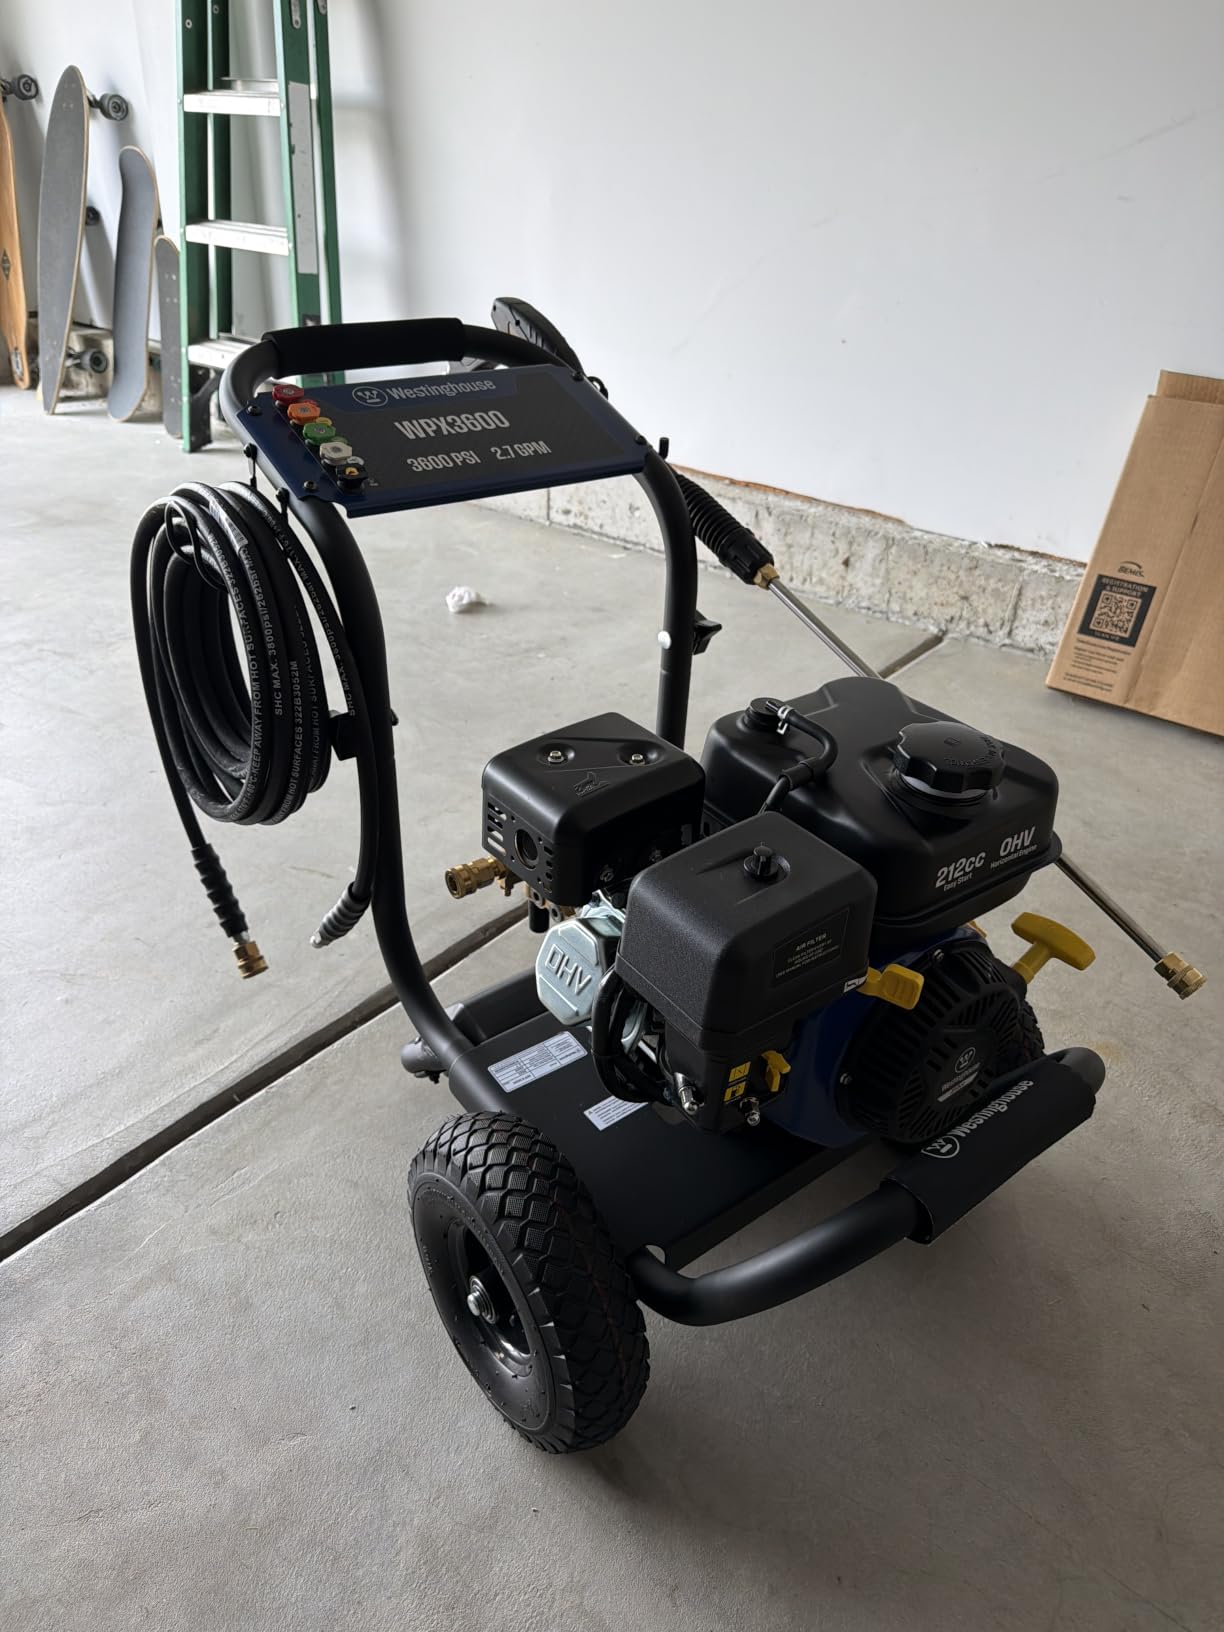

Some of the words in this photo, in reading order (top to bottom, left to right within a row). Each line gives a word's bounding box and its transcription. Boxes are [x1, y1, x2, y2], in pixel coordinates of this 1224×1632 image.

[386, 379, 497, 400] Westinghouse
[394, 410, 511, 440] WPX3600
[406, 454, 454, 472] 3600
[451, 450, 481, 467] PSI
[490, 446, 516, 460] 2.7
[516, 440, 552, 457] GPM
[249, 654, 260, 680] HOT
[252, 682, 263, 715] FROM
[274, 691, 283, 716] SHC
[253, 718, 263, 748] AWAY
[293, 727, 303, 778] SURFACES
[1000, 826, 1036, 857] OHV
[935, 852, 986, 889] 212cc
[544, 943, 592, 996] OHV
[947, 1080, 1035, 1138] Westinghouse
